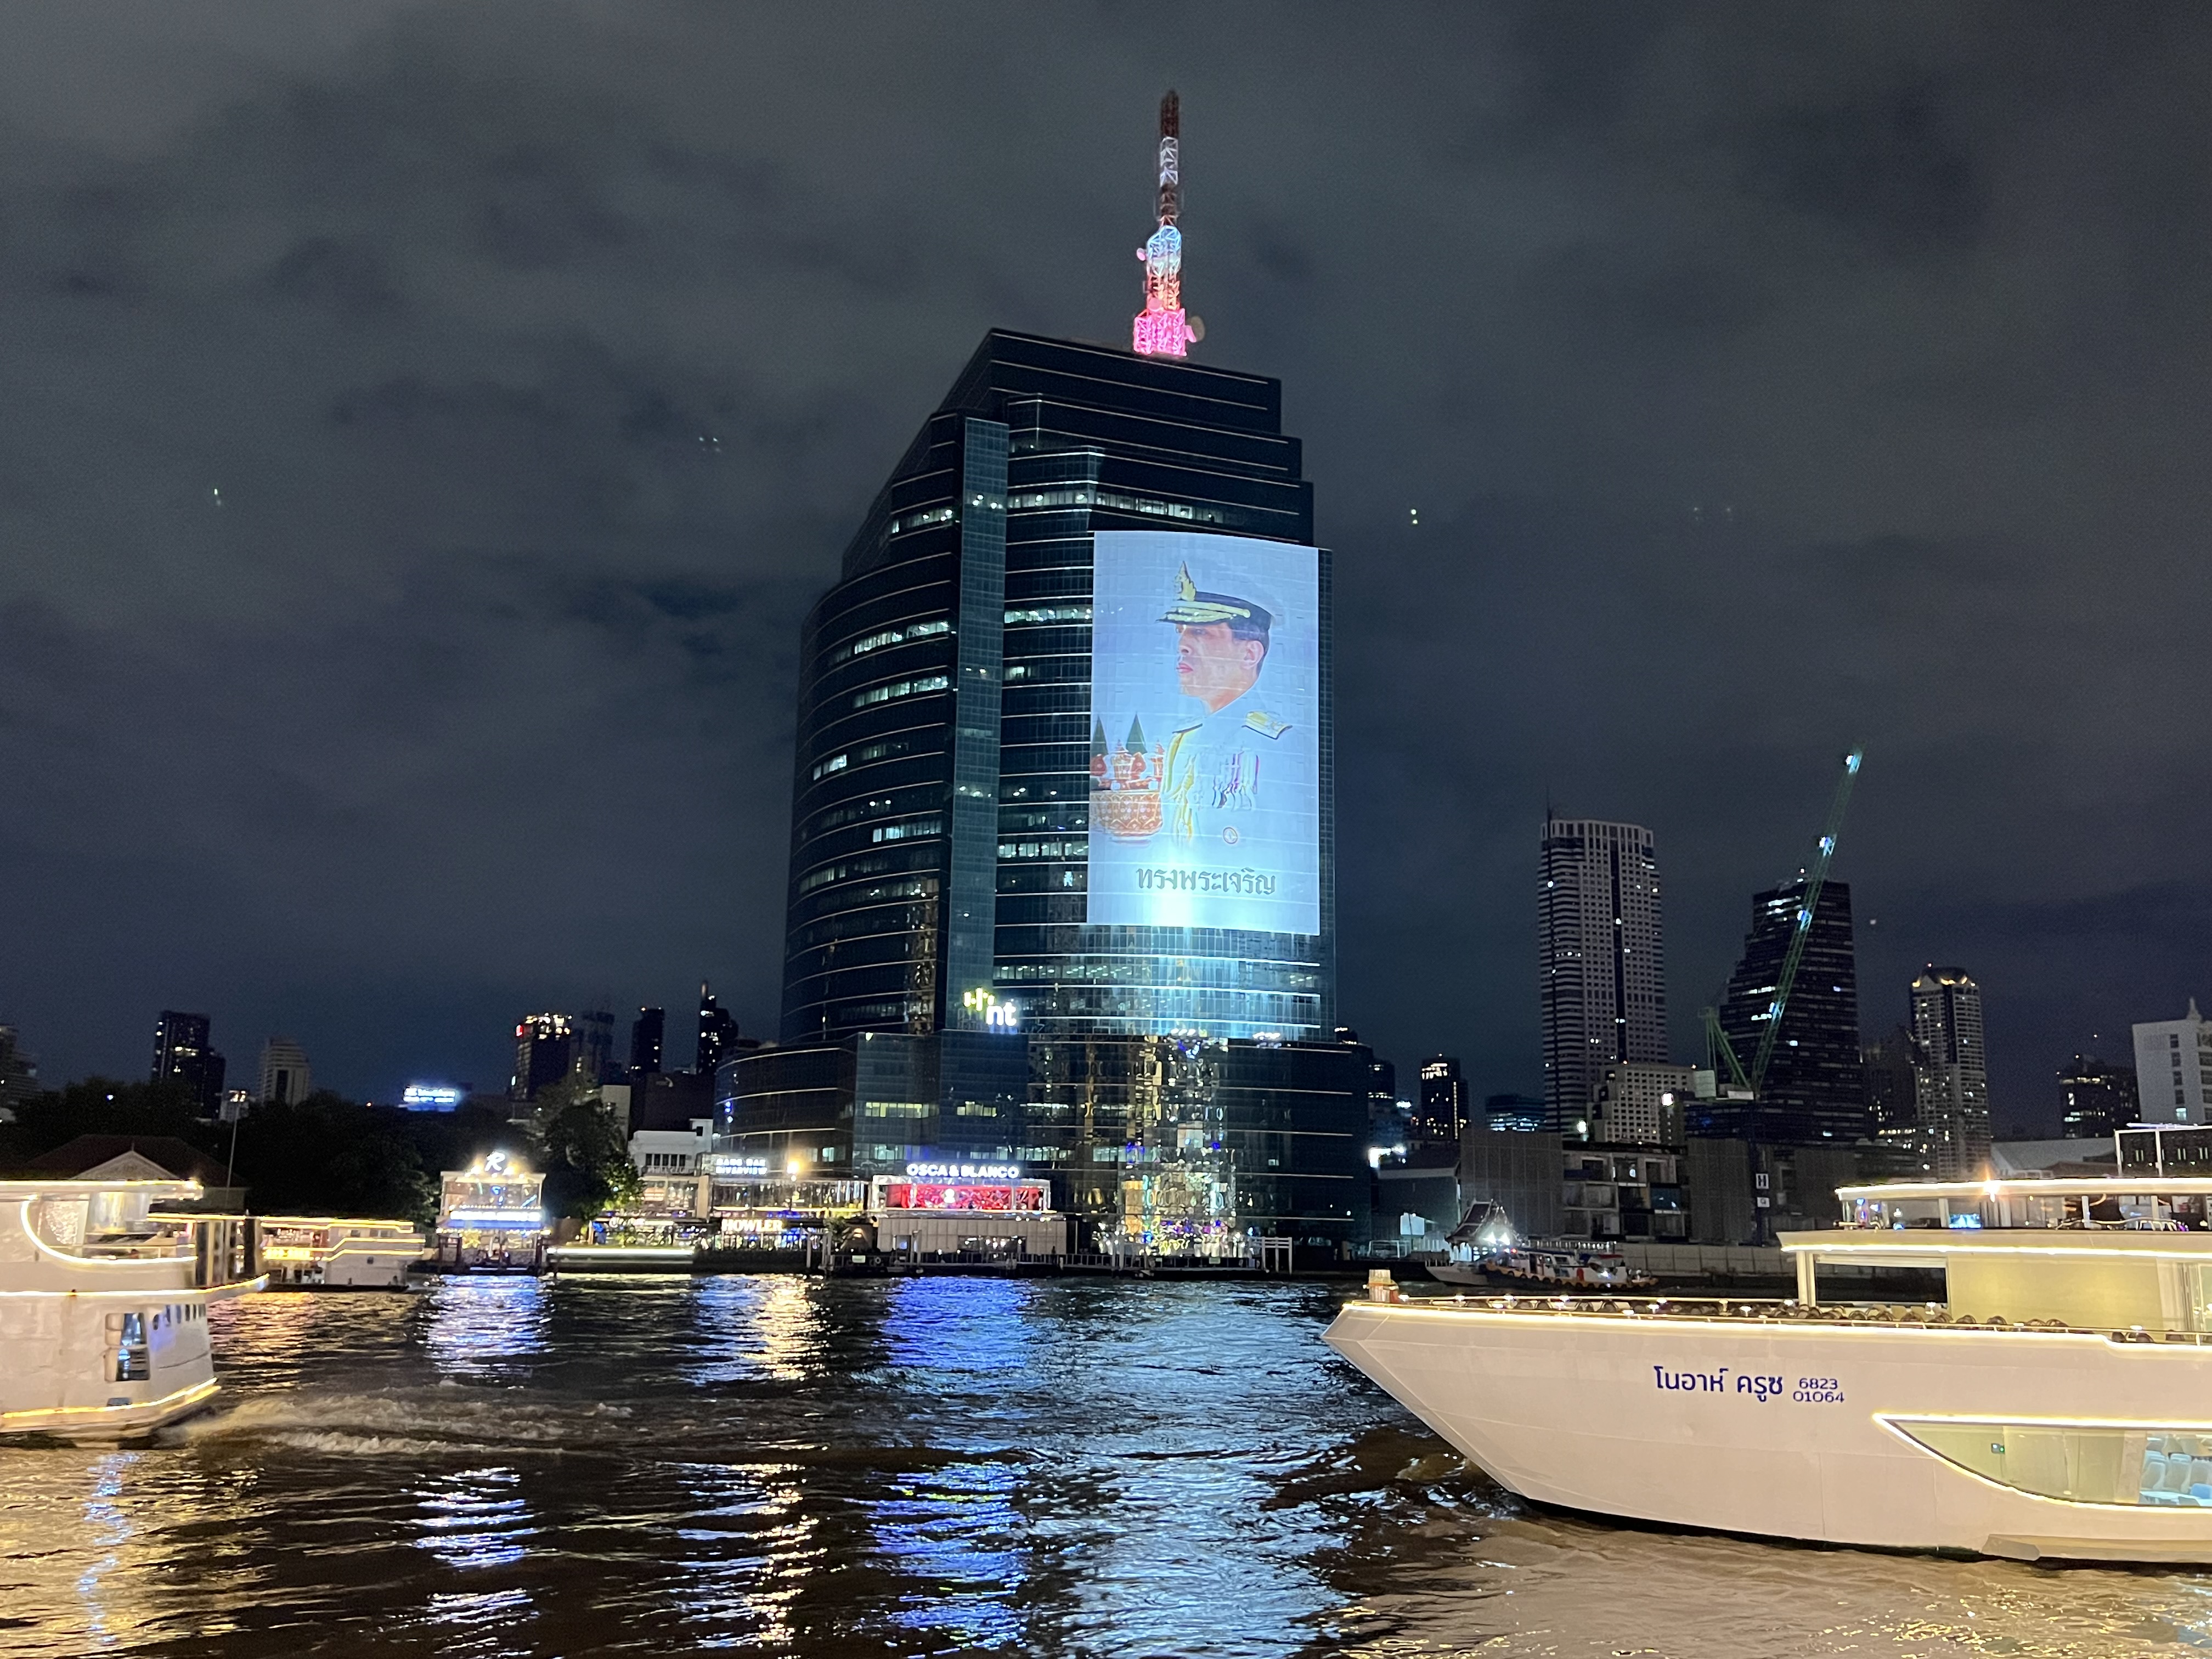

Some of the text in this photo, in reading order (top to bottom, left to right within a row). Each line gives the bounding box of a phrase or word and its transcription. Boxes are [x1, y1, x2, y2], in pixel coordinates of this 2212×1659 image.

[1136, 867, 1276, 895] ทรงพระเจริญ
[986, 1002, 1017, 1027] nt
[485, 1151, 506, 1171] R
[721, 1218, 783, 1232] HOWLER
[1654, 1365, 1729, 1392] โนอาห์
[1799, 1378, 1838, 1390] 6823
[1793, 1391, 1845, 1403] 01064
